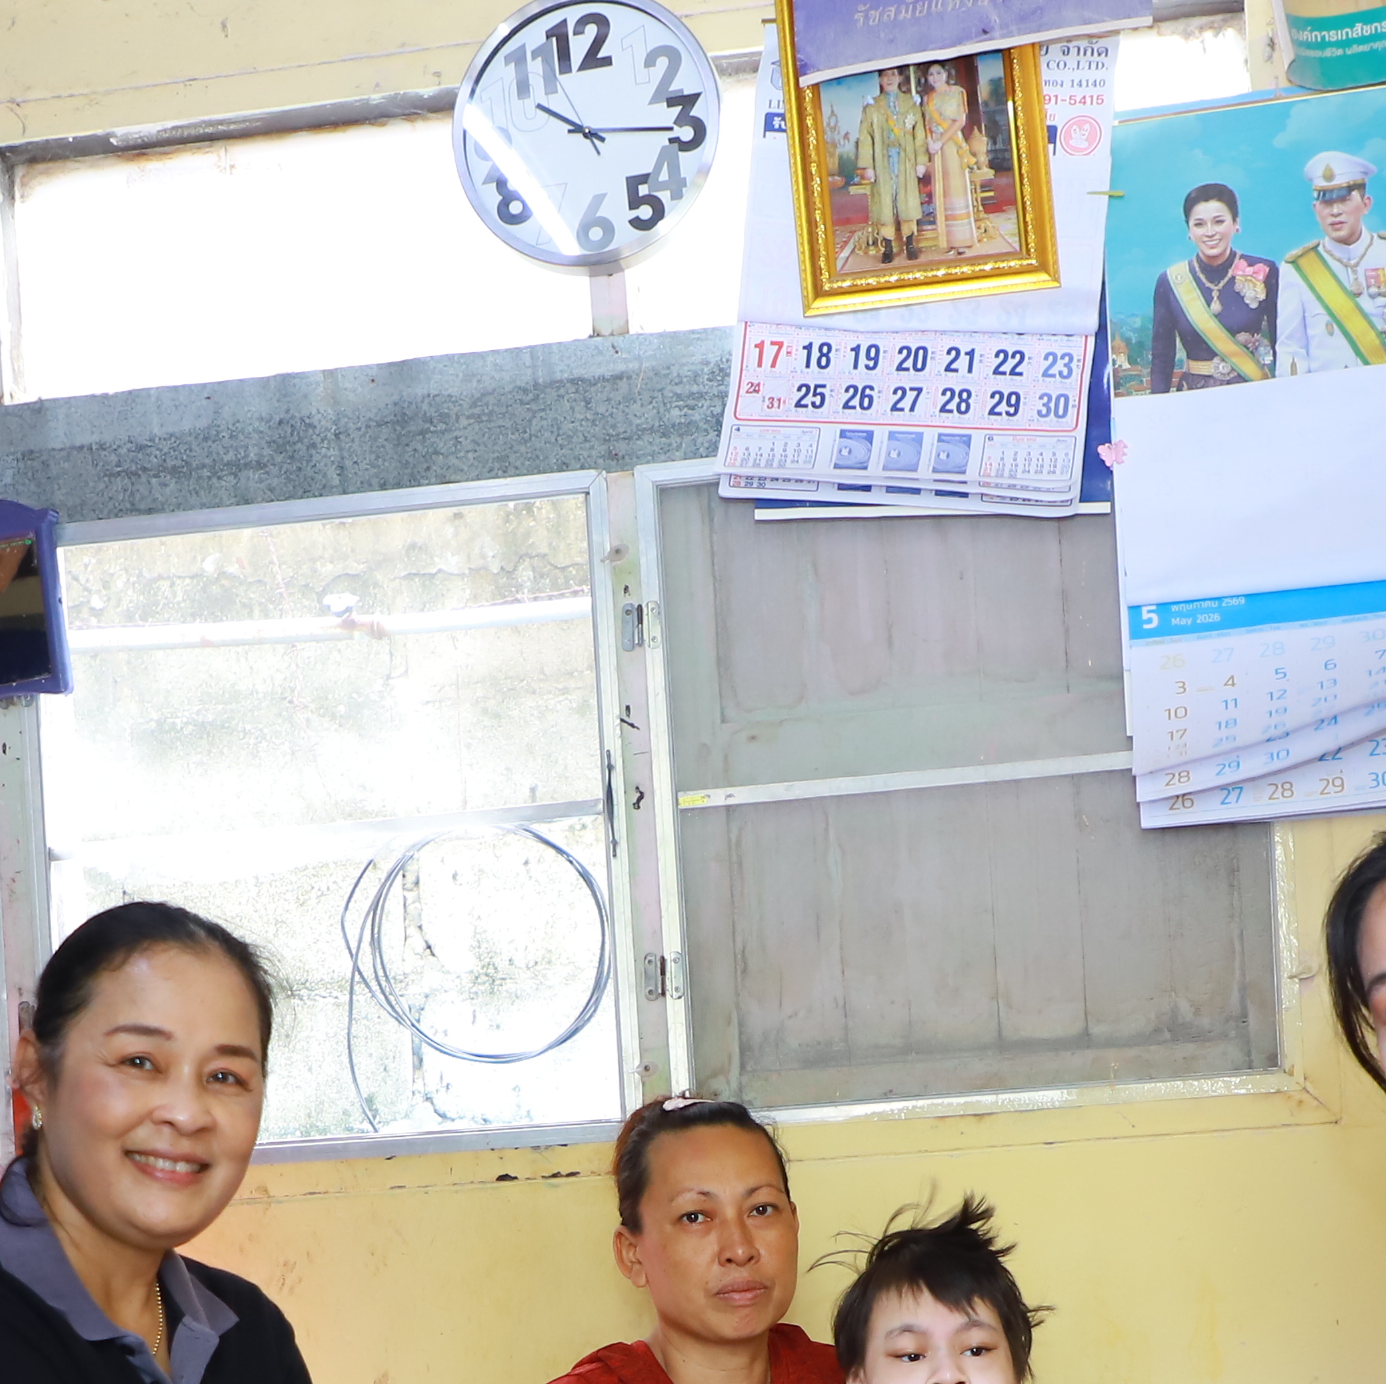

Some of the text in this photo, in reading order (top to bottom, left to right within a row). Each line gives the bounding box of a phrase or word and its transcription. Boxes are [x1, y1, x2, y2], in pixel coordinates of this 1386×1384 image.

[545, 12, 613, 75] 12
[504, 38, 559, 100] 11
[644, 44, 684, 106] 2
[1046, 60, 1109, 71] CO.,LTD.
[1070, 79, 1106, 88] 14140
[666, 92, 707, 153] 3
[647, 143, 687, 201] 4
[626, 173, 665, 231] 5
[577, 193, 615, 252] 6
[754, 340, 1075, 379] 17 18 19 20 21 22 23
[745, 381, 1070, 419] 24 25 26 27 28 29 30
[766, 397, 782, 409] 31
[1141, 605, 1159, 629] 5
[1171, 613, 1221, 627] May 2026
[1175, 681, 1187, 695] 3
[1223, 674, 1237, 688] 4
[1274, 667, 1288, 680] 5
[1324, 659, 1337, 670] 6
[1375, 649, 1386, 660] 7
[1164, 706, 1188, 721] 10
[1221, 698, 1239, 711] 11
[1266, 689, 1288, 701] 12
[1317, 678, 1338, 690] 13
[1167, 728, 1188, 742] 17
[1215, 718, 1238, 732] 18
[1164, 749, 1290, 787] 28 29 30
[1168, 793, 1195, 811] 26
[1220, 786, 1244, 805] 27
[1267, 781, 1295, 801] 28
[1319, 776, 1345, 796] 29
